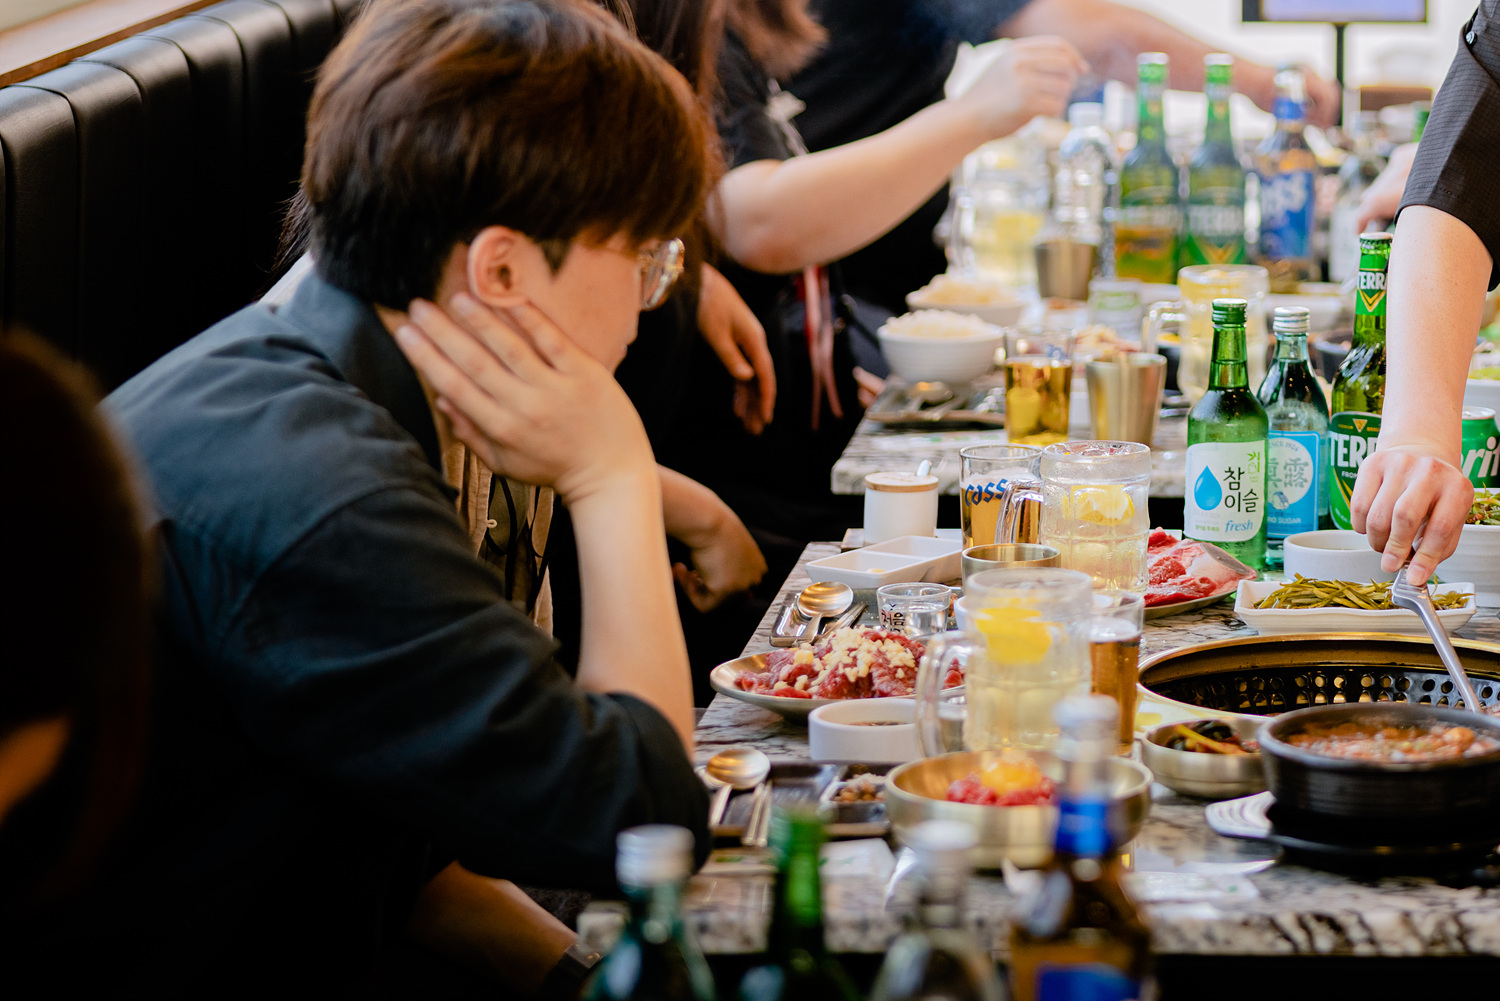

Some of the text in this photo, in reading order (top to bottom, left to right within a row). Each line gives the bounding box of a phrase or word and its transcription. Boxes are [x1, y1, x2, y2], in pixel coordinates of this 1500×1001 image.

[1329, 432, 1379, 468] TER
[1223, 466, 1245, 491] 참
[1224, 488, 1259, 513] 이슬
[1225, 519, 1254, 533] fresh
